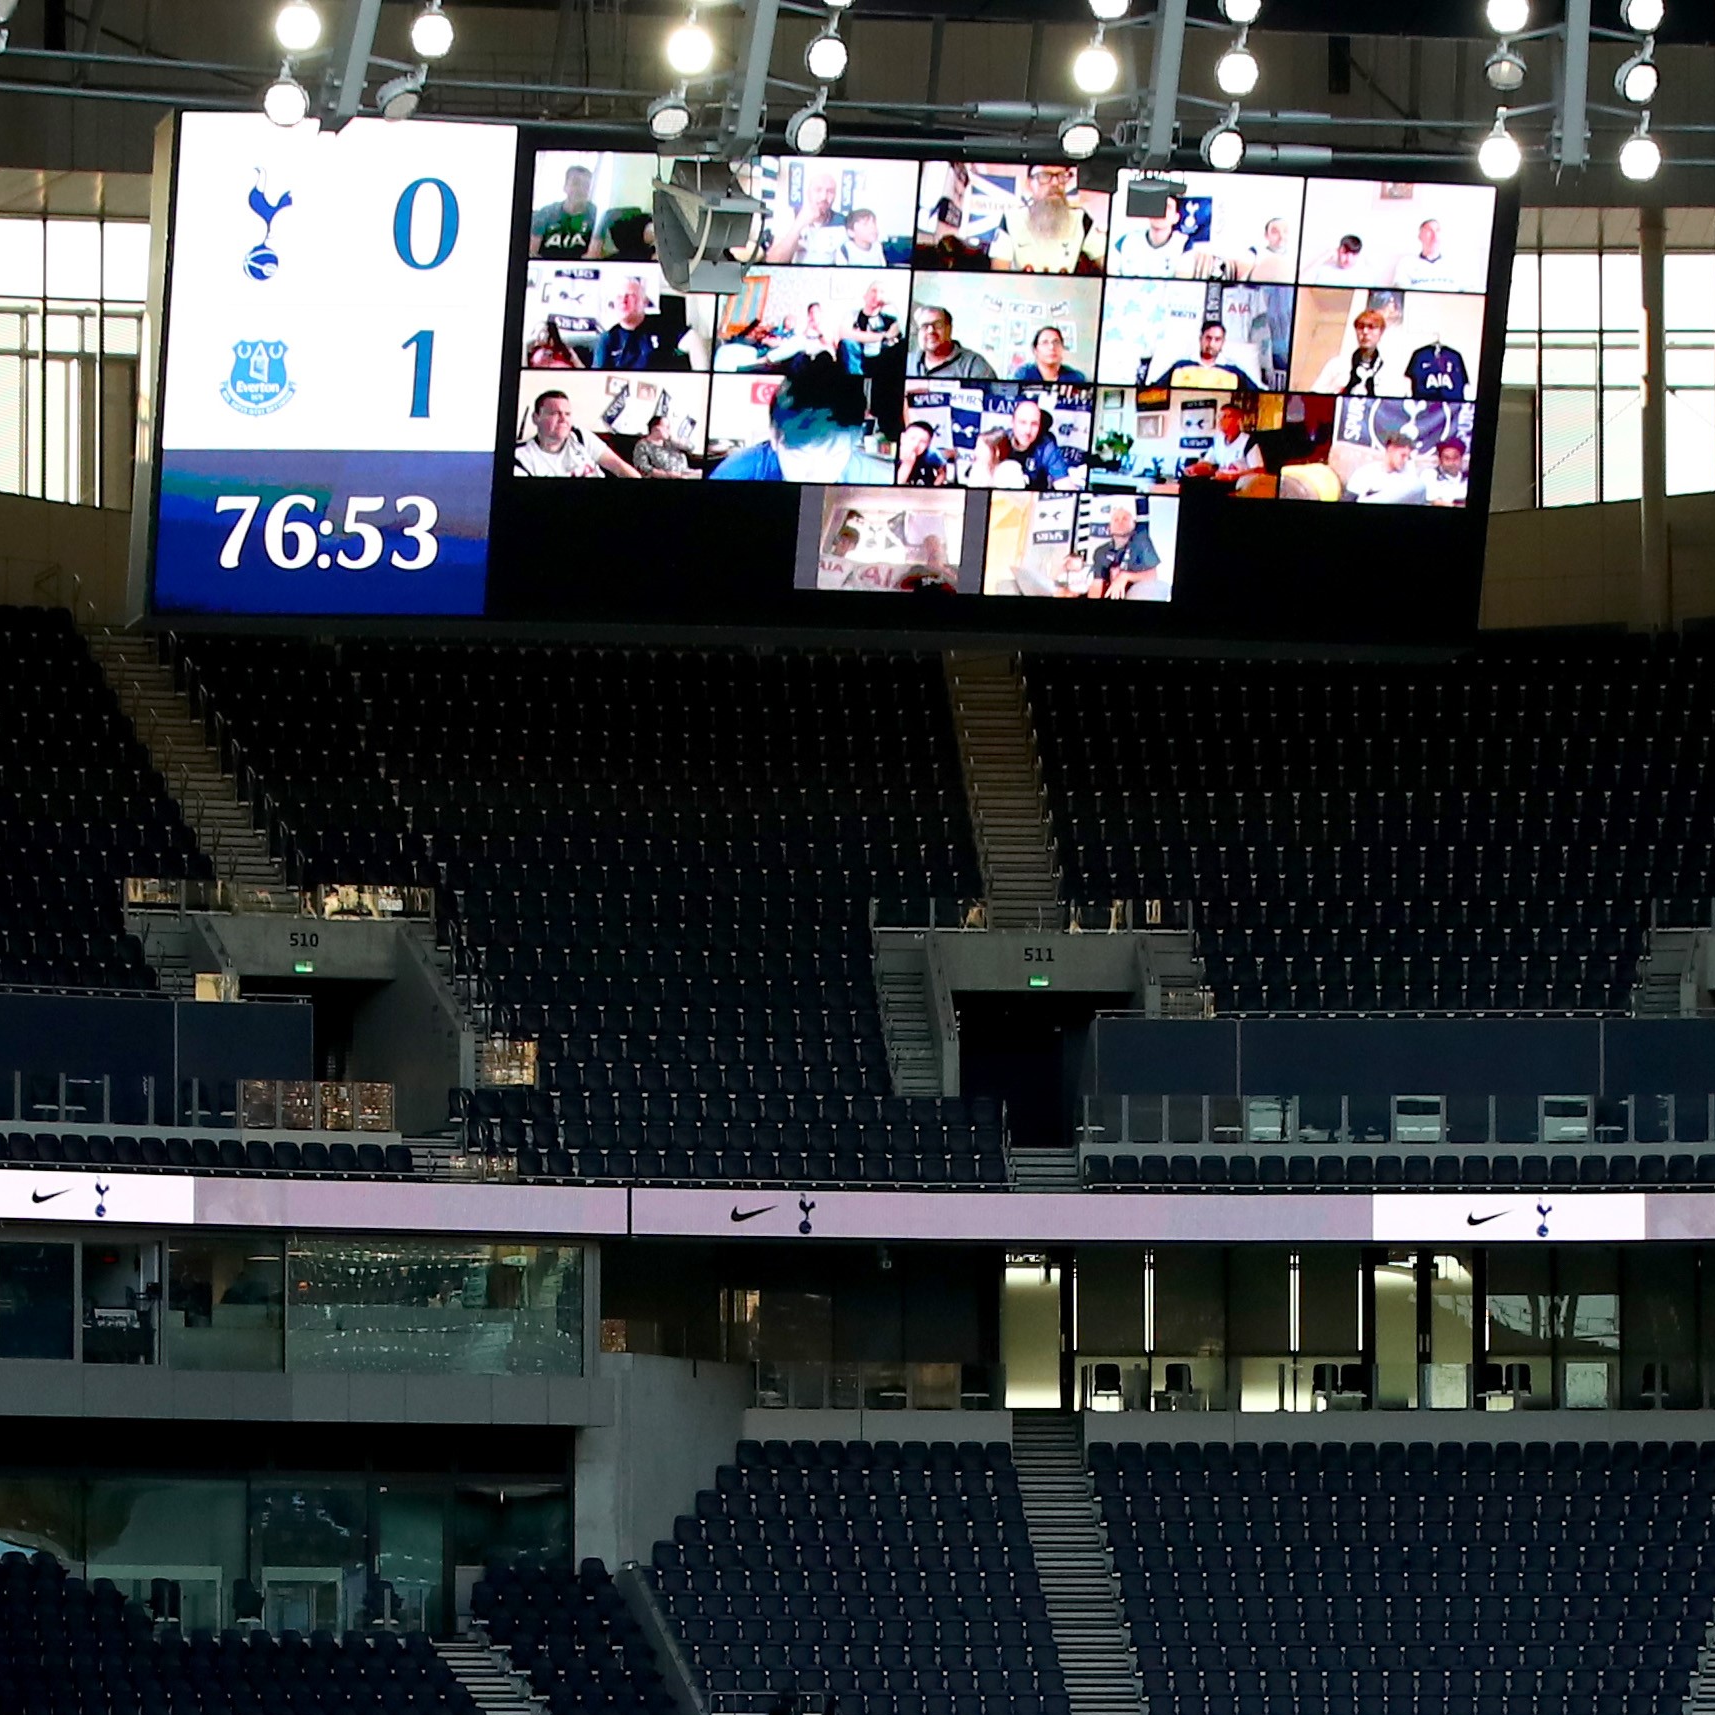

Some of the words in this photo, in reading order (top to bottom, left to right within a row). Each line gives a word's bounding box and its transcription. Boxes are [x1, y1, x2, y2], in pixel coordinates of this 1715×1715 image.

[393, 177, 460, 270] 0
[545, 233, 586, 248] AIA
[401, 330, 435, 418] 1
[1425, 375, 1453, 389] AIA
[214, 494, 440, 571] 76:53
[289, 932, 319, 947] 510
[1024, 947, 1054, 961] 511
